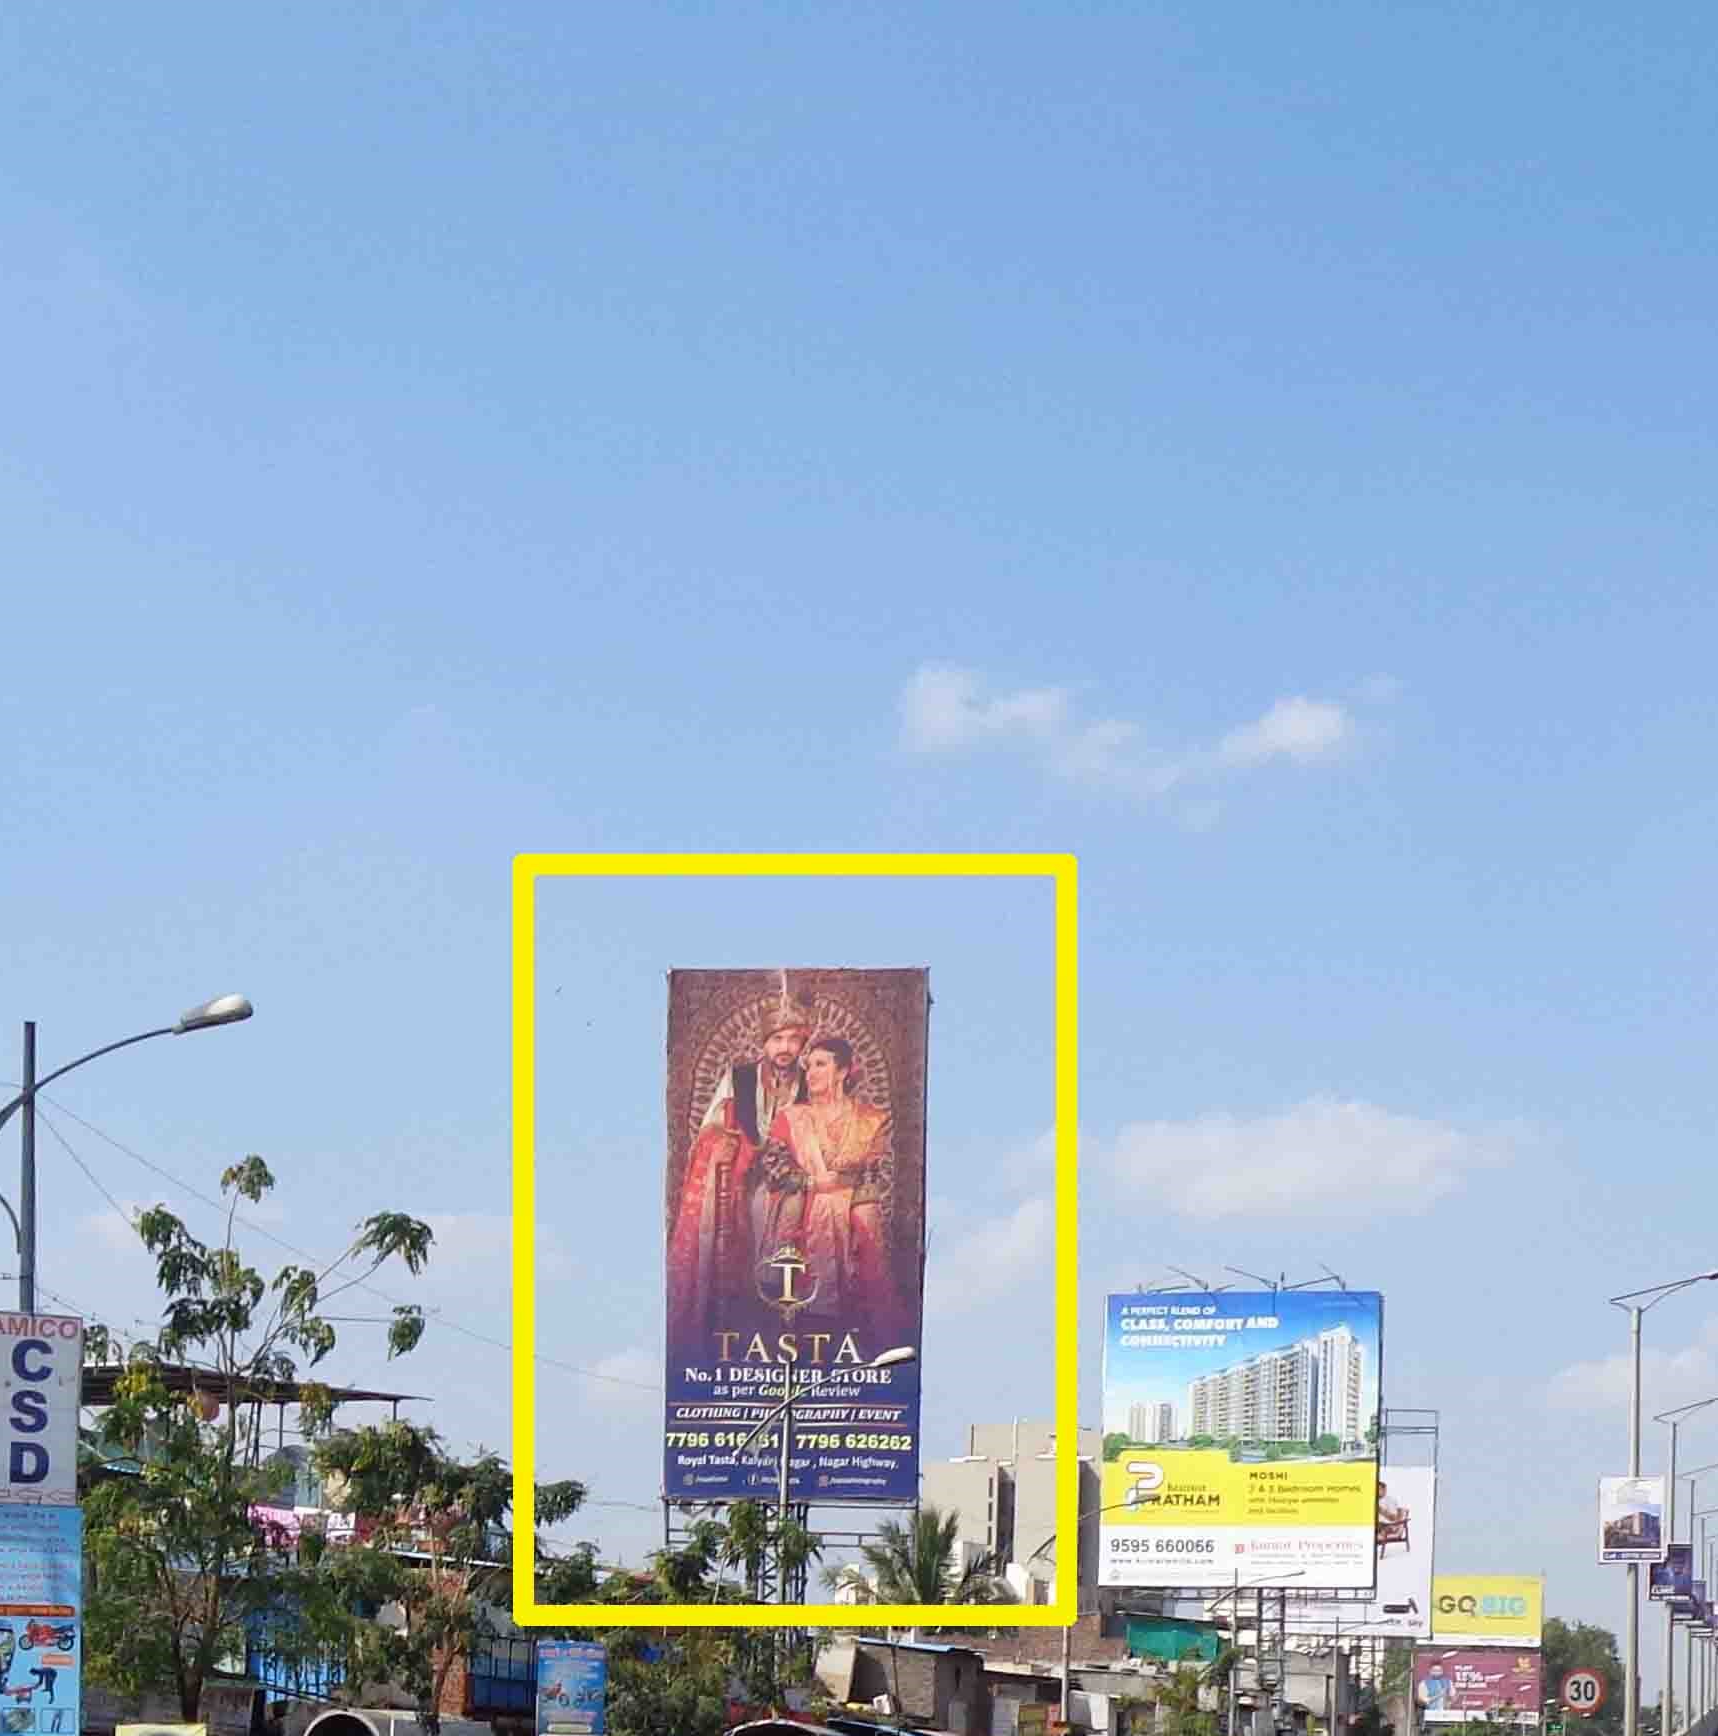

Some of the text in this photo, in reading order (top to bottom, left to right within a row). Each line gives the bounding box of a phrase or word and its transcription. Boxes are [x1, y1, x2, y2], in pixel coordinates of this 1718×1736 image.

[1173, 1318, 1244, 1331] COMFORT
[1246, 1316, 1279, 1329] AND
[713, 1331, 864, 1364] TASTA
[1120, 1334, 1227, 1347] CONNECTIVITY
[729, 1367, 824, 1384] DESIGER
[713, 1387, 729, 1396] as
[732, 1386, 755, 1398] per
[811, 1386, 861, 1397] Review
[676, 1408, 742, 1419] CLOTHING
[858, 1410, 902, 1421] EVENT
[666, 1432, 709, 1447] 7796
[796, 1434, 840, 1448] 7796
[678, 1455, 706, 1468] Royal
[818, 1456, 849, 1469] Nagar
[1249, 1472, 1288, 1480] MOSHI
[1111, 1538, 1215, 1553] 9595 660066
[1568, 1678, 1596, 1702] 30
